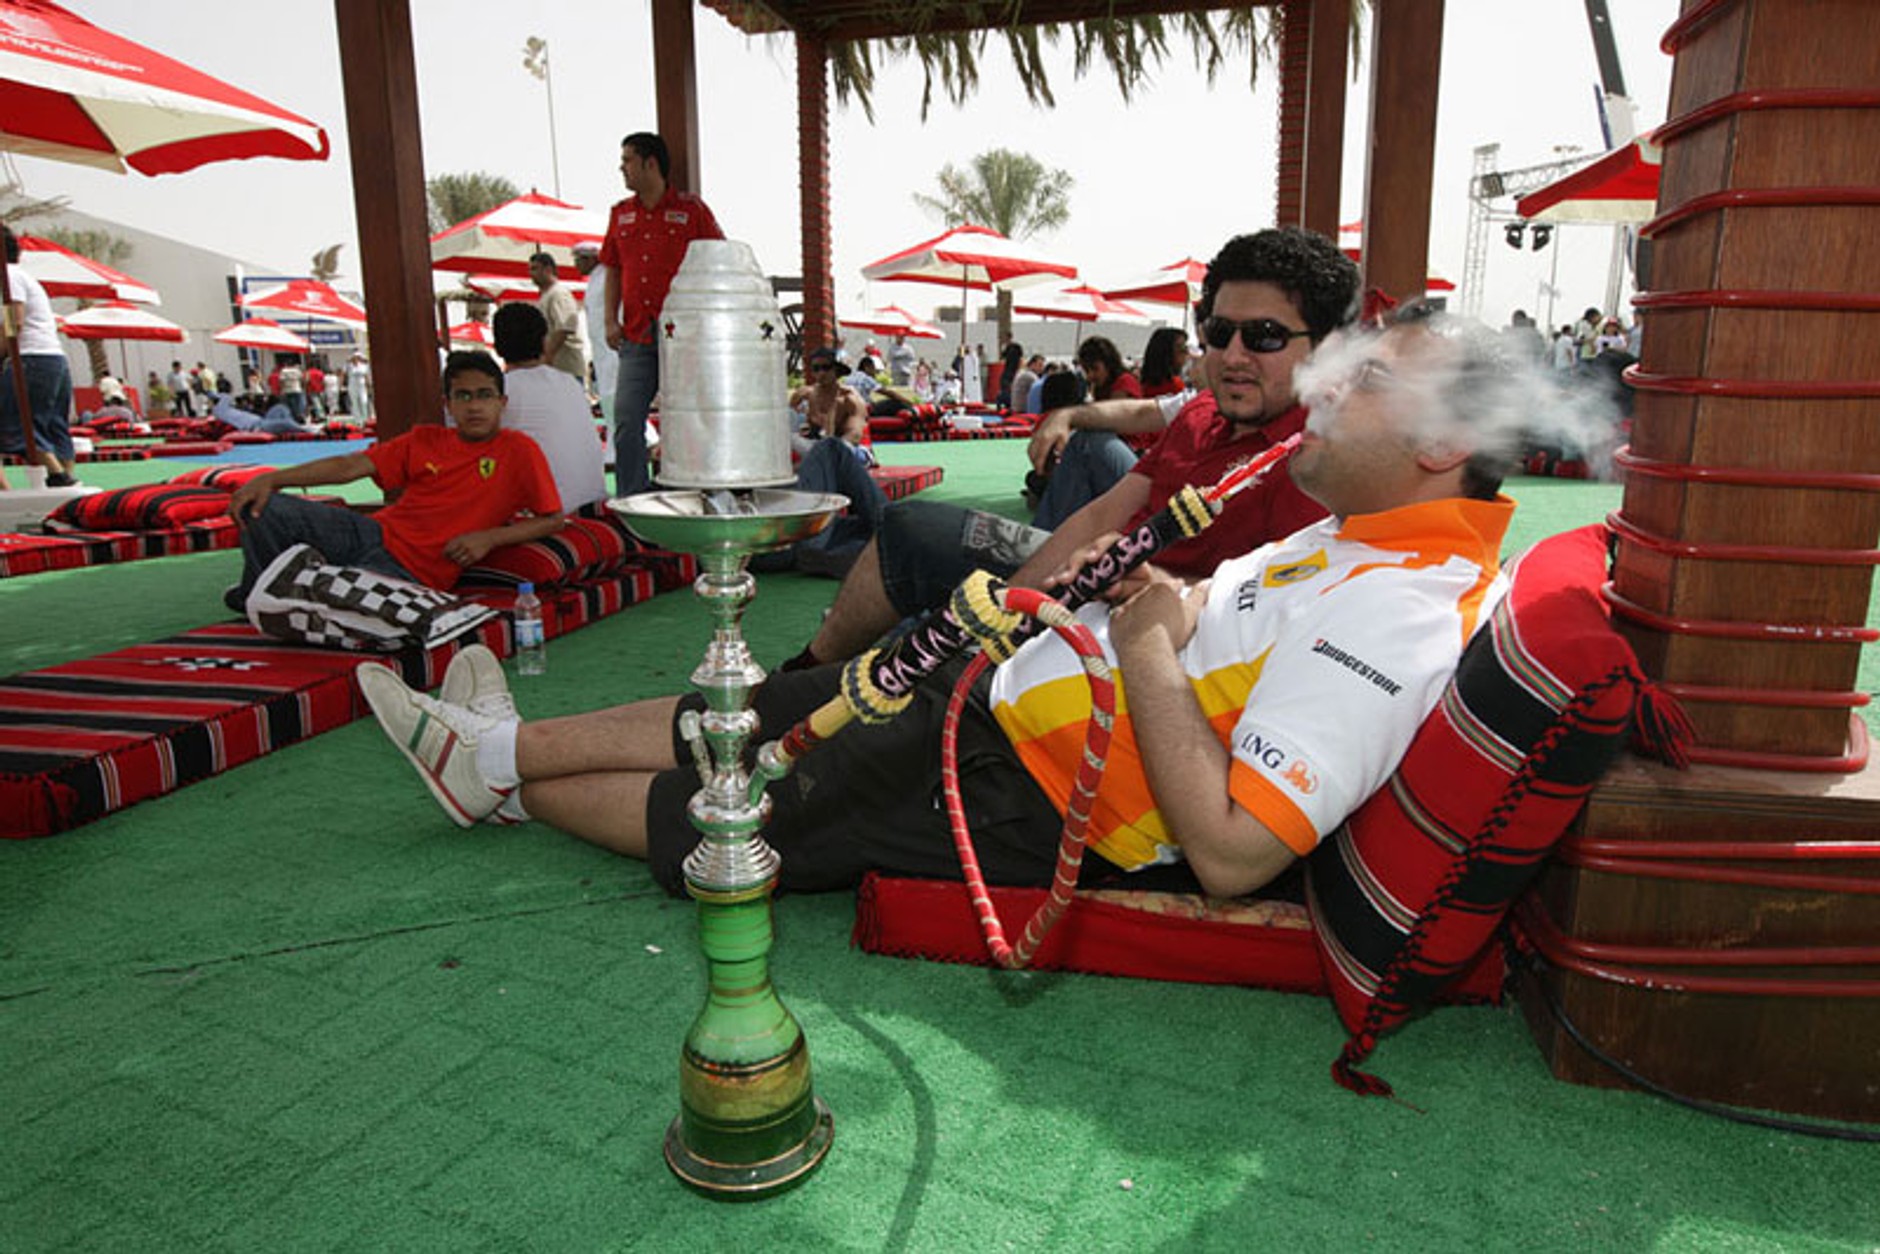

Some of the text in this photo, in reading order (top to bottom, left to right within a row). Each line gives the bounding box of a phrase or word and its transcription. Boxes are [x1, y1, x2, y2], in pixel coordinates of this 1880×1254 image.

[1237, 577, 1258, 612] ULT
[1311, 638, 1402, 697] BRIDGESTONE
[1241, 732, 1285, 769] ING
